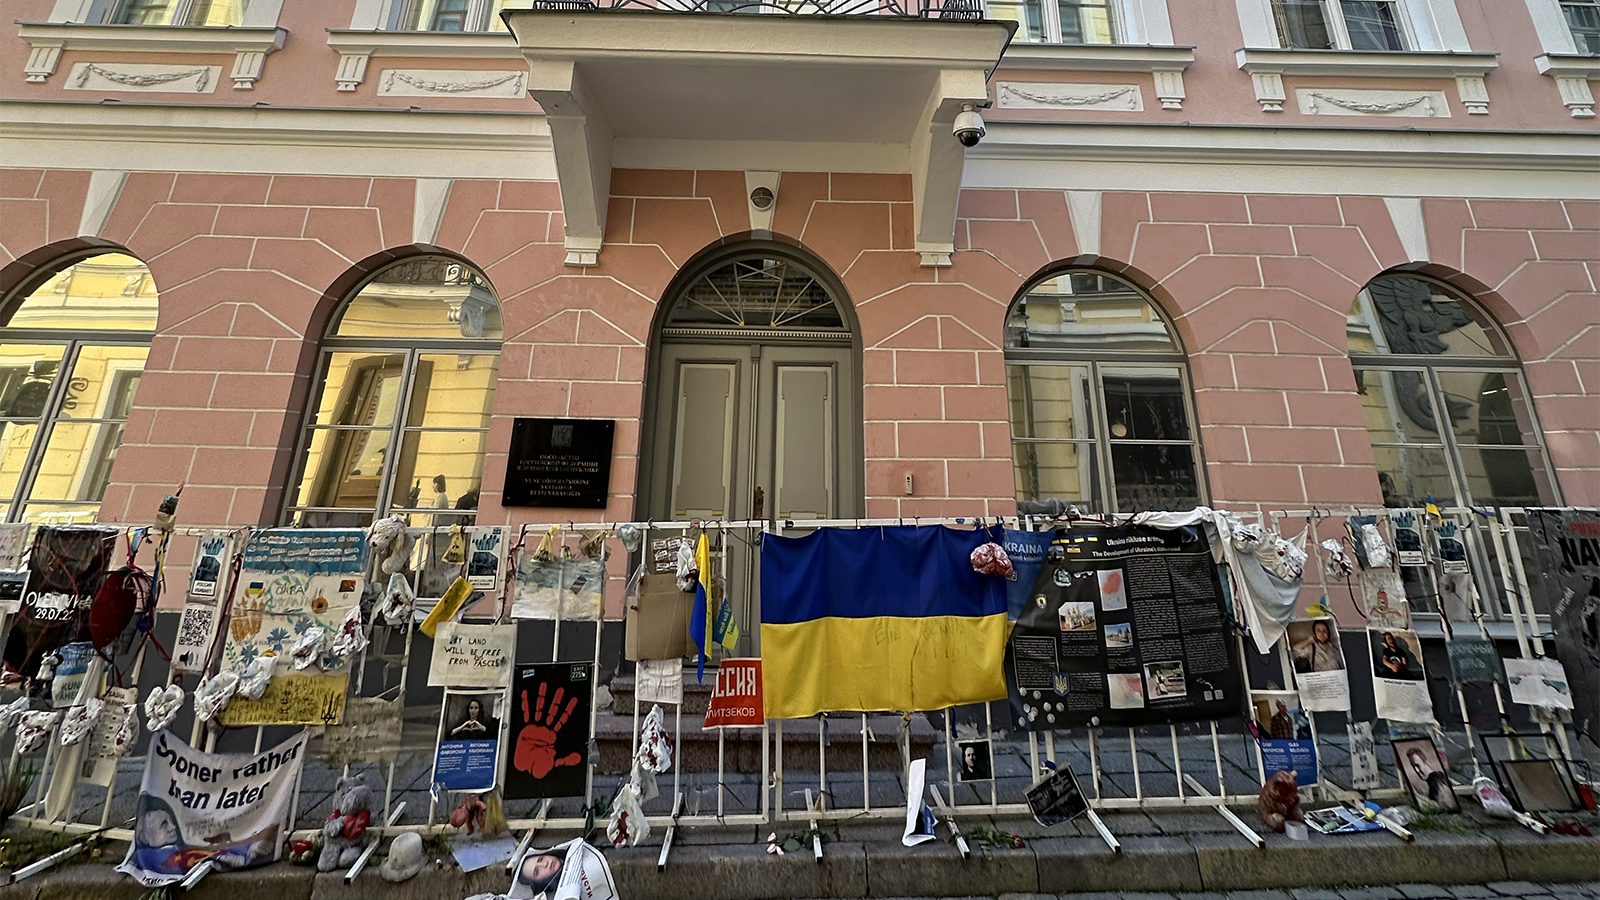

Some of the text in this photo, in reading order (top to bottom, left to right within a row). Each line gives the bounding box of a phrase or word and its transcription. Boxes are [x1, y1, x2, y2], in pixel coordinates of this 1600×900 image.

[1003, 541, 1043, 554] KRAINA
[1106, 538, 1126, 546] Ukraina
[468, 637, 487, 646] LAND
[444, 646, 465, 655] WILL
[480, 649, 501, 659] FREE
[448, 658, 469, 666] FROM
[711, 667, 756, 698] ССИЯ
[704, 707, 756, 719] ЛИТЗЕКОВ
[233, 741, 302, 780] rather
[216, 781, 270, 810] later
